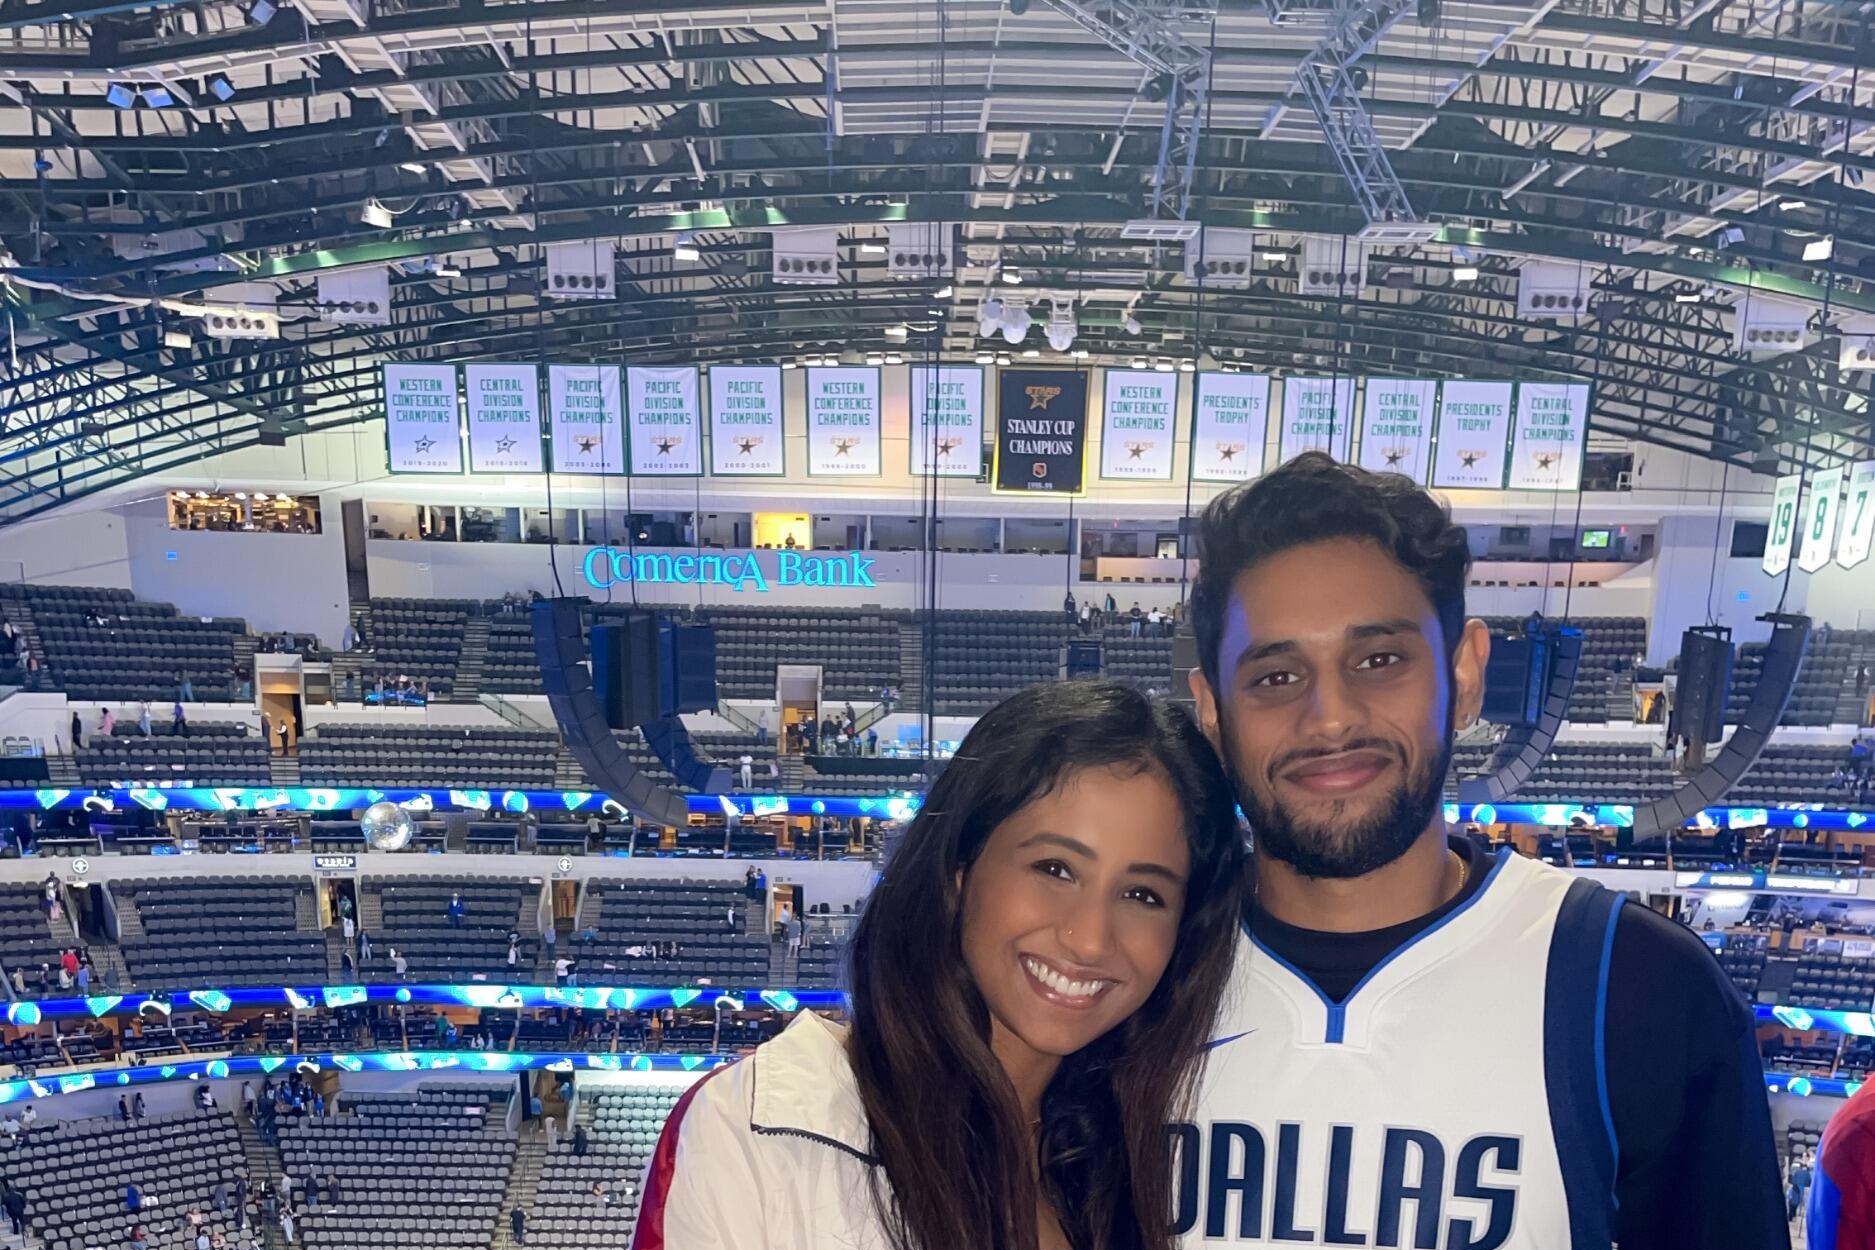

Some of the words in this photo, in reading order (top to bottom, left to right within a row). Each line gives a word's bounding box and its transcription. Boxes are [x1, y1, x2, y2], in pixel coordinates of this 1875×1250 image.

[400, 379, 442, 391] WESTERN
[480, 379, 524, 391] CENTRAL
[645, 382, 681, 393] PACIFIC
[728, 382, 763, 393] PACIFIC
[823, 382, 864, 394] WESTERN
[1120, 386, 1161, 399] WESTERN
[1302, 392, 1336, 405] PACIFI
[392, 394, 452, 407] CONFERENCE
[483, 395, 523, 407] DIVISION
[566, 396, 605, 408] DIVISION
[645, 397, 683, 409] DIVISION
[727, 397, 765, 409] DIVISION
[815, 398, 872, 410] CONFERENCE
[1379, 394, 1420, 406] CENTRAL
[1531, 397, 1573, 411] CENTRAL
[1111, 401, 1168, 414] CONFERENCE
[1299, 408, 1337, 419] DIVISION
[396, 410, 449, 423] CHAMPIONS
[478, 410, 530, 422] CHAMPIONS
[560, 412, 613, 423] CHAMPIONS
[639, 413, 691, 425] CHAMPIONS
[720, 413, 772, 424] CHAMPIONS
[818, 413, 870, 425] CHAMPIONS
[1215, 411, 1248, 424] TROPHY
[1379, 409, 1418, 421] DIVISION
[1532, 413, 1570, 425] DIVISION
[1008, 419, 1052, 435] STANLEY
[1054, 420, 1075, 435] CUP
[1114, 417, 1165, 430] CHAMPIONS
[1292, 423, 1343, 435] CHAMPIONS
[1457, 418, 1491, 431] TROPHY
[1371, 424, 1422, 437] CHAMPIONS
[1523, 428, 1575, 441] CHAMPIONS
[1009, 440, 1072, 455] CHAMPIONS
[1812, 497, 1828, 541] 8
[1851, 490, 1868, 536] 7
[1772, 502, 1792, 546] 19
[776, 551, 876, 587] Bank
